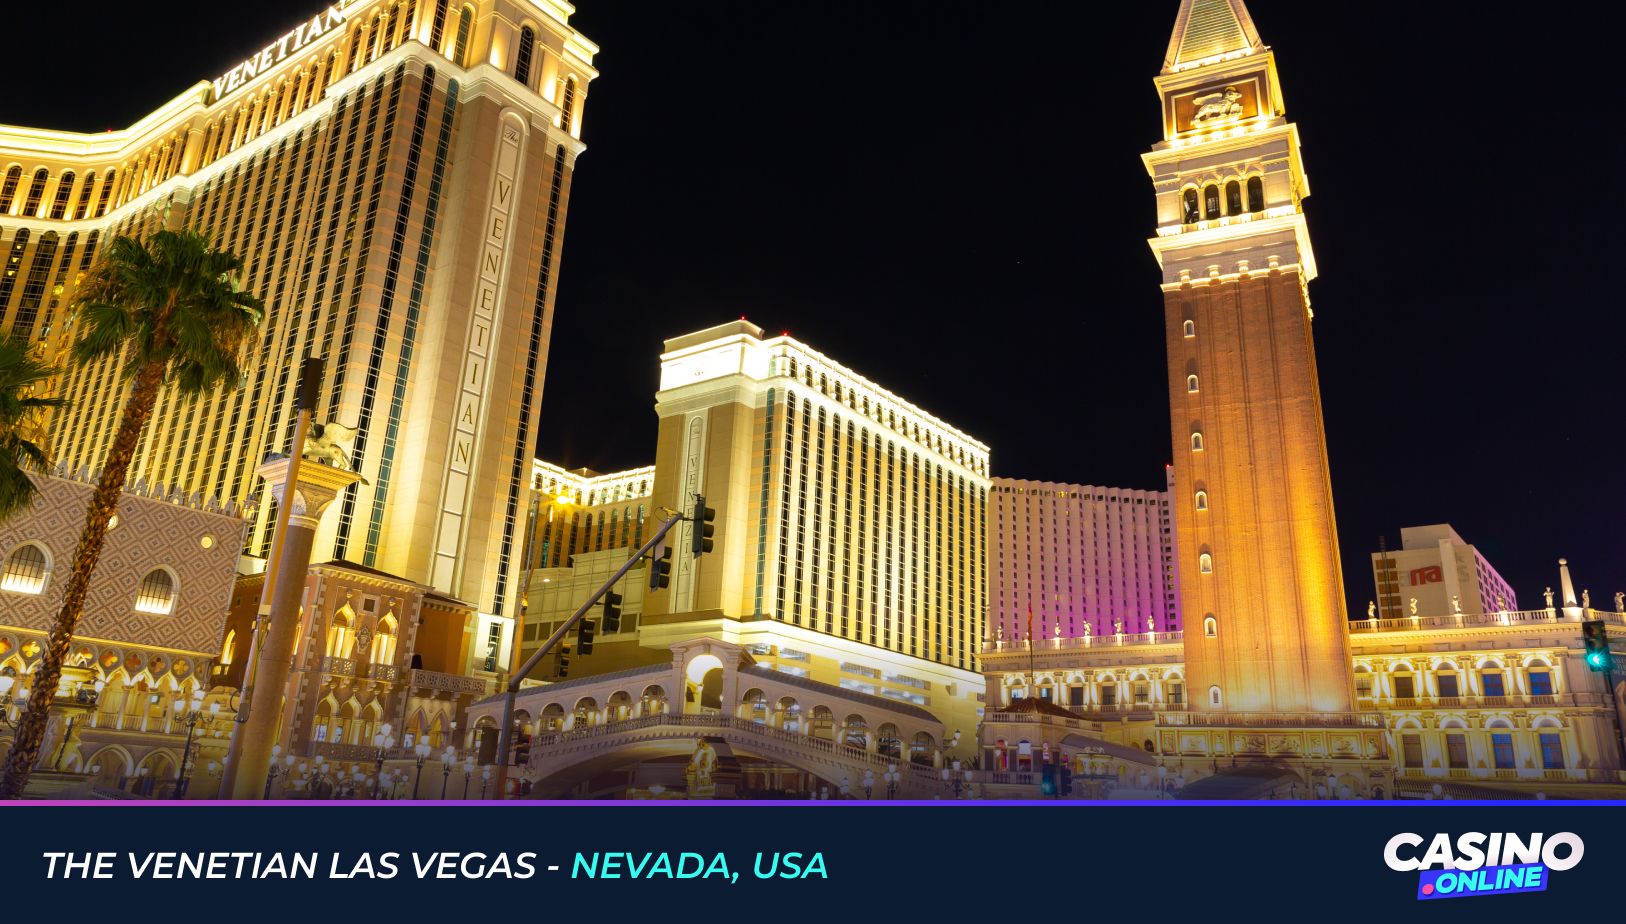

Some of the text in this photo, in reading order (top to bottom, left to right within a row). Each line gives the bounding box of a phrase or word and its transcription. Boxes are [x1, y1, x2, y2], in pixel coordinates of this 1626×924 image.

[213, 0, 346, 100] VENETIAN
[455, 179, 511, 465] VENETIAN
[681, 456, 698, 571] VENEZIA
